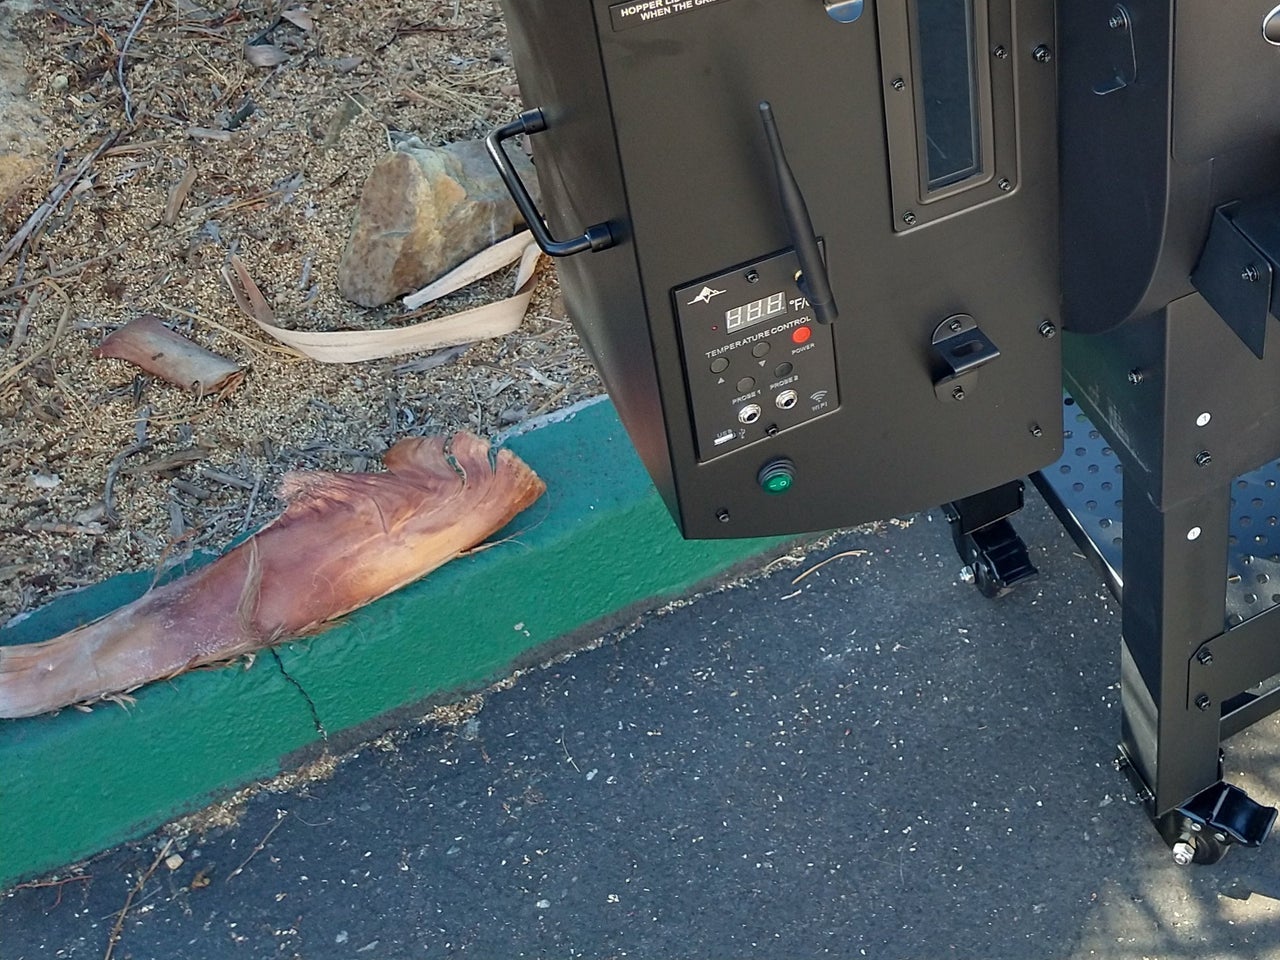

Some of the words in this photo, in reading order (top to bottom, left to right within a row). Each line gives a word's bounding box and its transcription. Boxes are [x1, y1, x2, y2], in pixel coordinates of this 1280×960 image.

[620, 0, 663, 17] HOPPER
[640, 7, 671, 21] WHEN
[672, 1, 693, 13] THE
[705, 330, 770, 359] TEMPERATURE
[770, 315, 812, 335] CONTROL
[791, 342, 815, 356] POWER
[769, 376, 793, 391] PROBE
